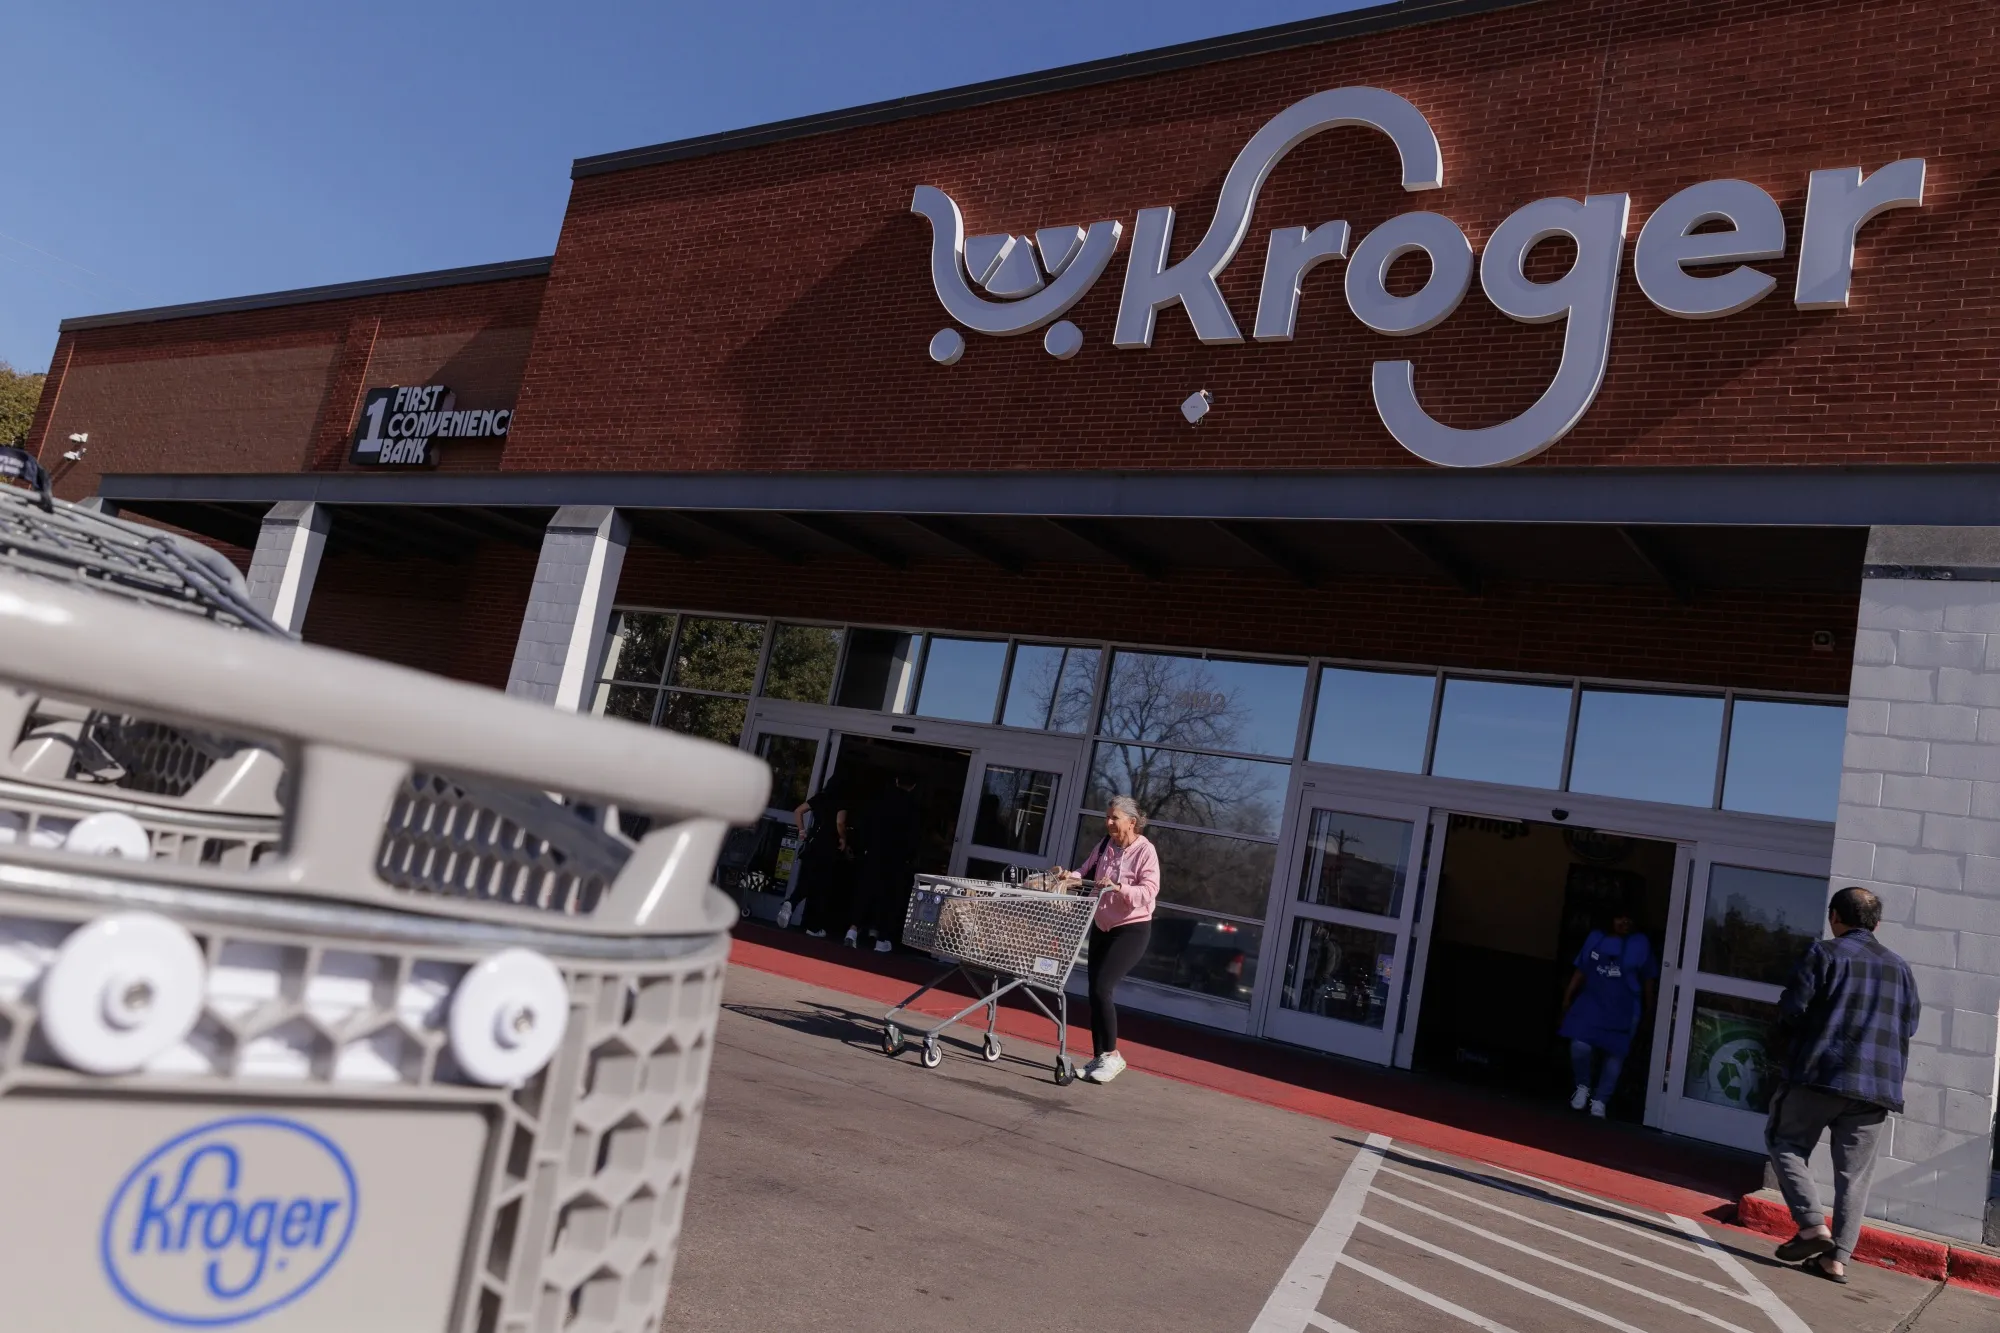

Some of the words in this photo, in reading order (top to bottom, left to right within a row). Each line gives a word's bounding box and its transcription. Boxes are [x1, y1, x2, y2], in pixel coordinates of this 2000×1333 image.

[1113, 85, 1926, 468] Kroger
[393, 385, 444, 412] FIRST
[357, 397, 388, 452] 1
[387, 409, 514, 438] CONVENIENC
[378, 438, 428, 464] BANK
[131, 1142, 342, 1299] Kroger
